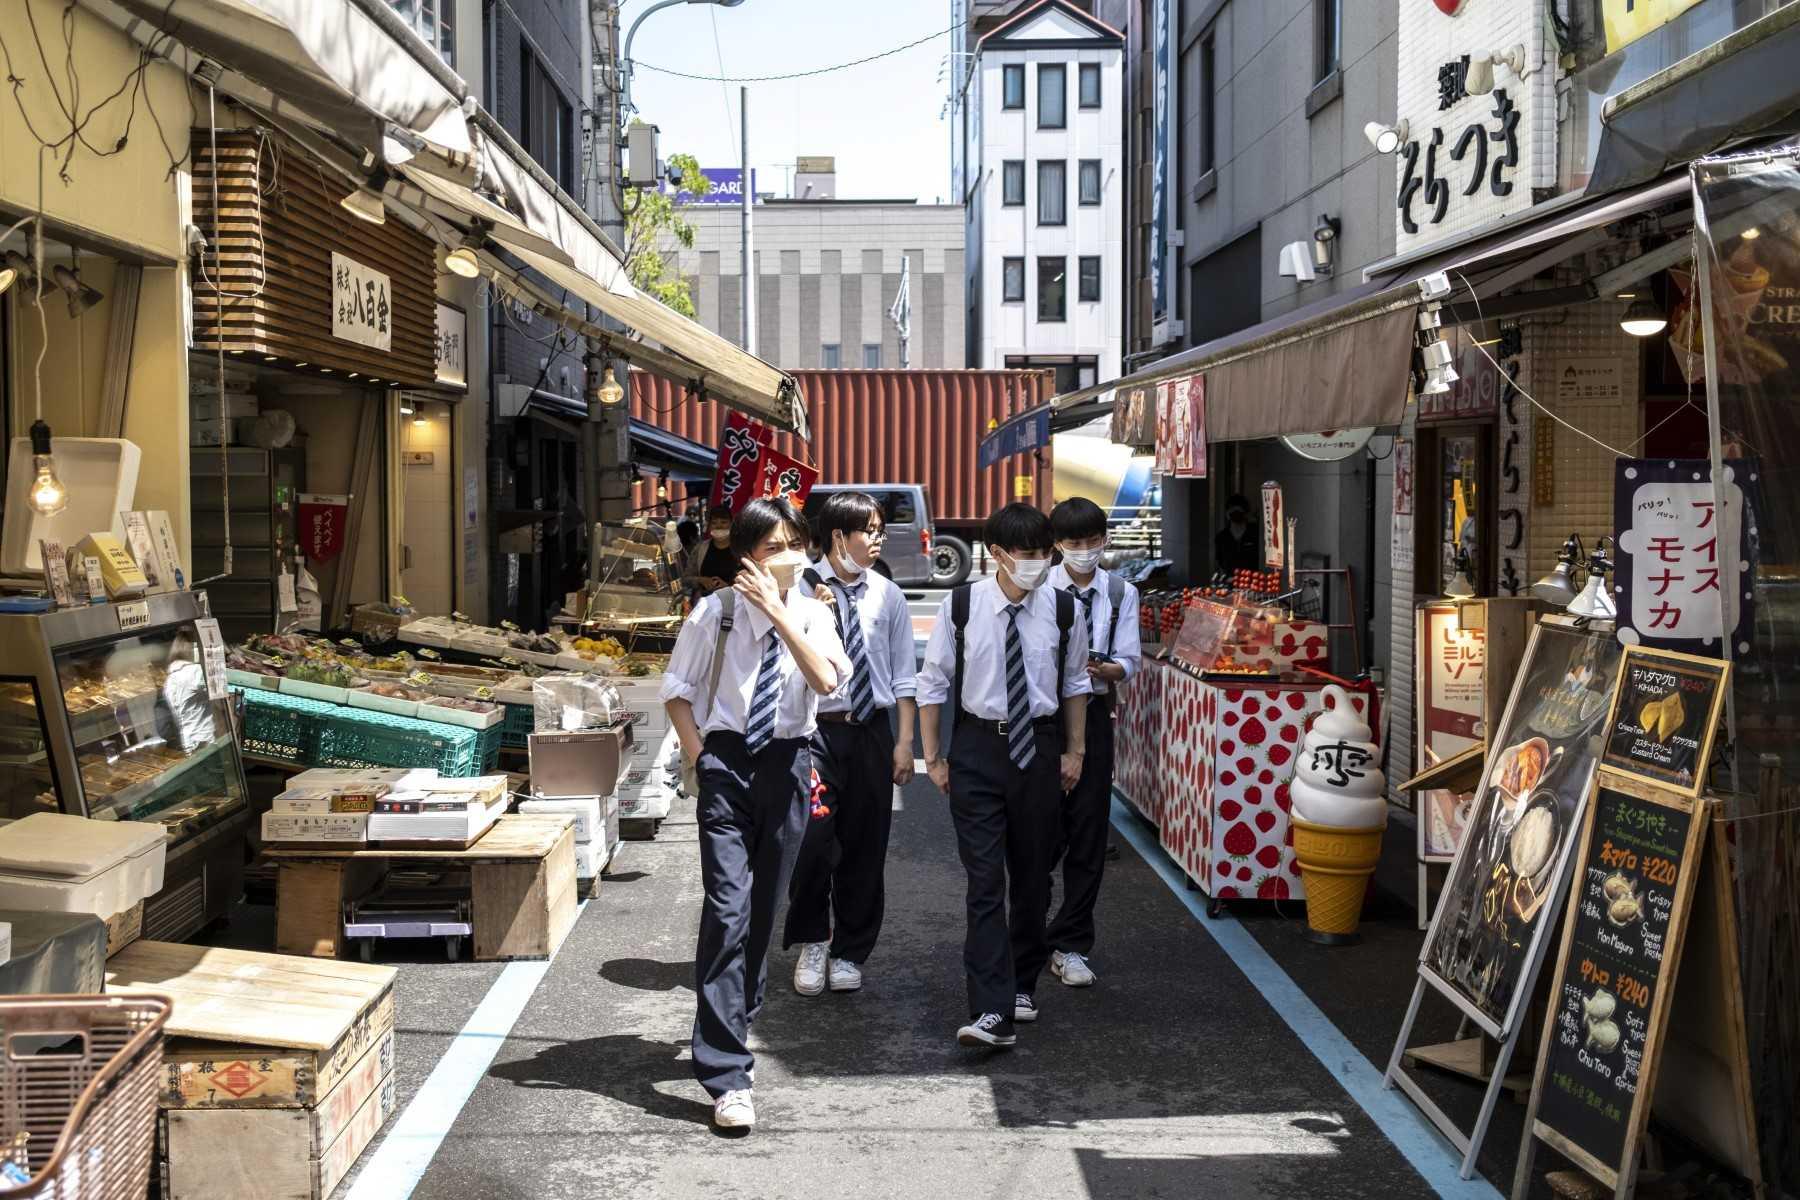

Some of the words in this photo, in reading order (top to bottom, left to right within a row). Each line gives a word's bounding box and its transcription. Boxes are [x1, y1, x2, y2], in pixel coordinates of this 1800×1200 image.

[1647, 537, 1685, 629] モナカ
[1633, 670, 1676, 686] キハダマグロ
[1601, 839, 1637, 869] 本マグロ
[1642, 855, 1677, 886] ¥220
[1648, 889, 1672, 908] Crispy
[1610, 934, 1634, 955] Maguro
[1616, 973, 1649, 1009] ¥240
[1594, 1057, 1611, 1078] Toro
